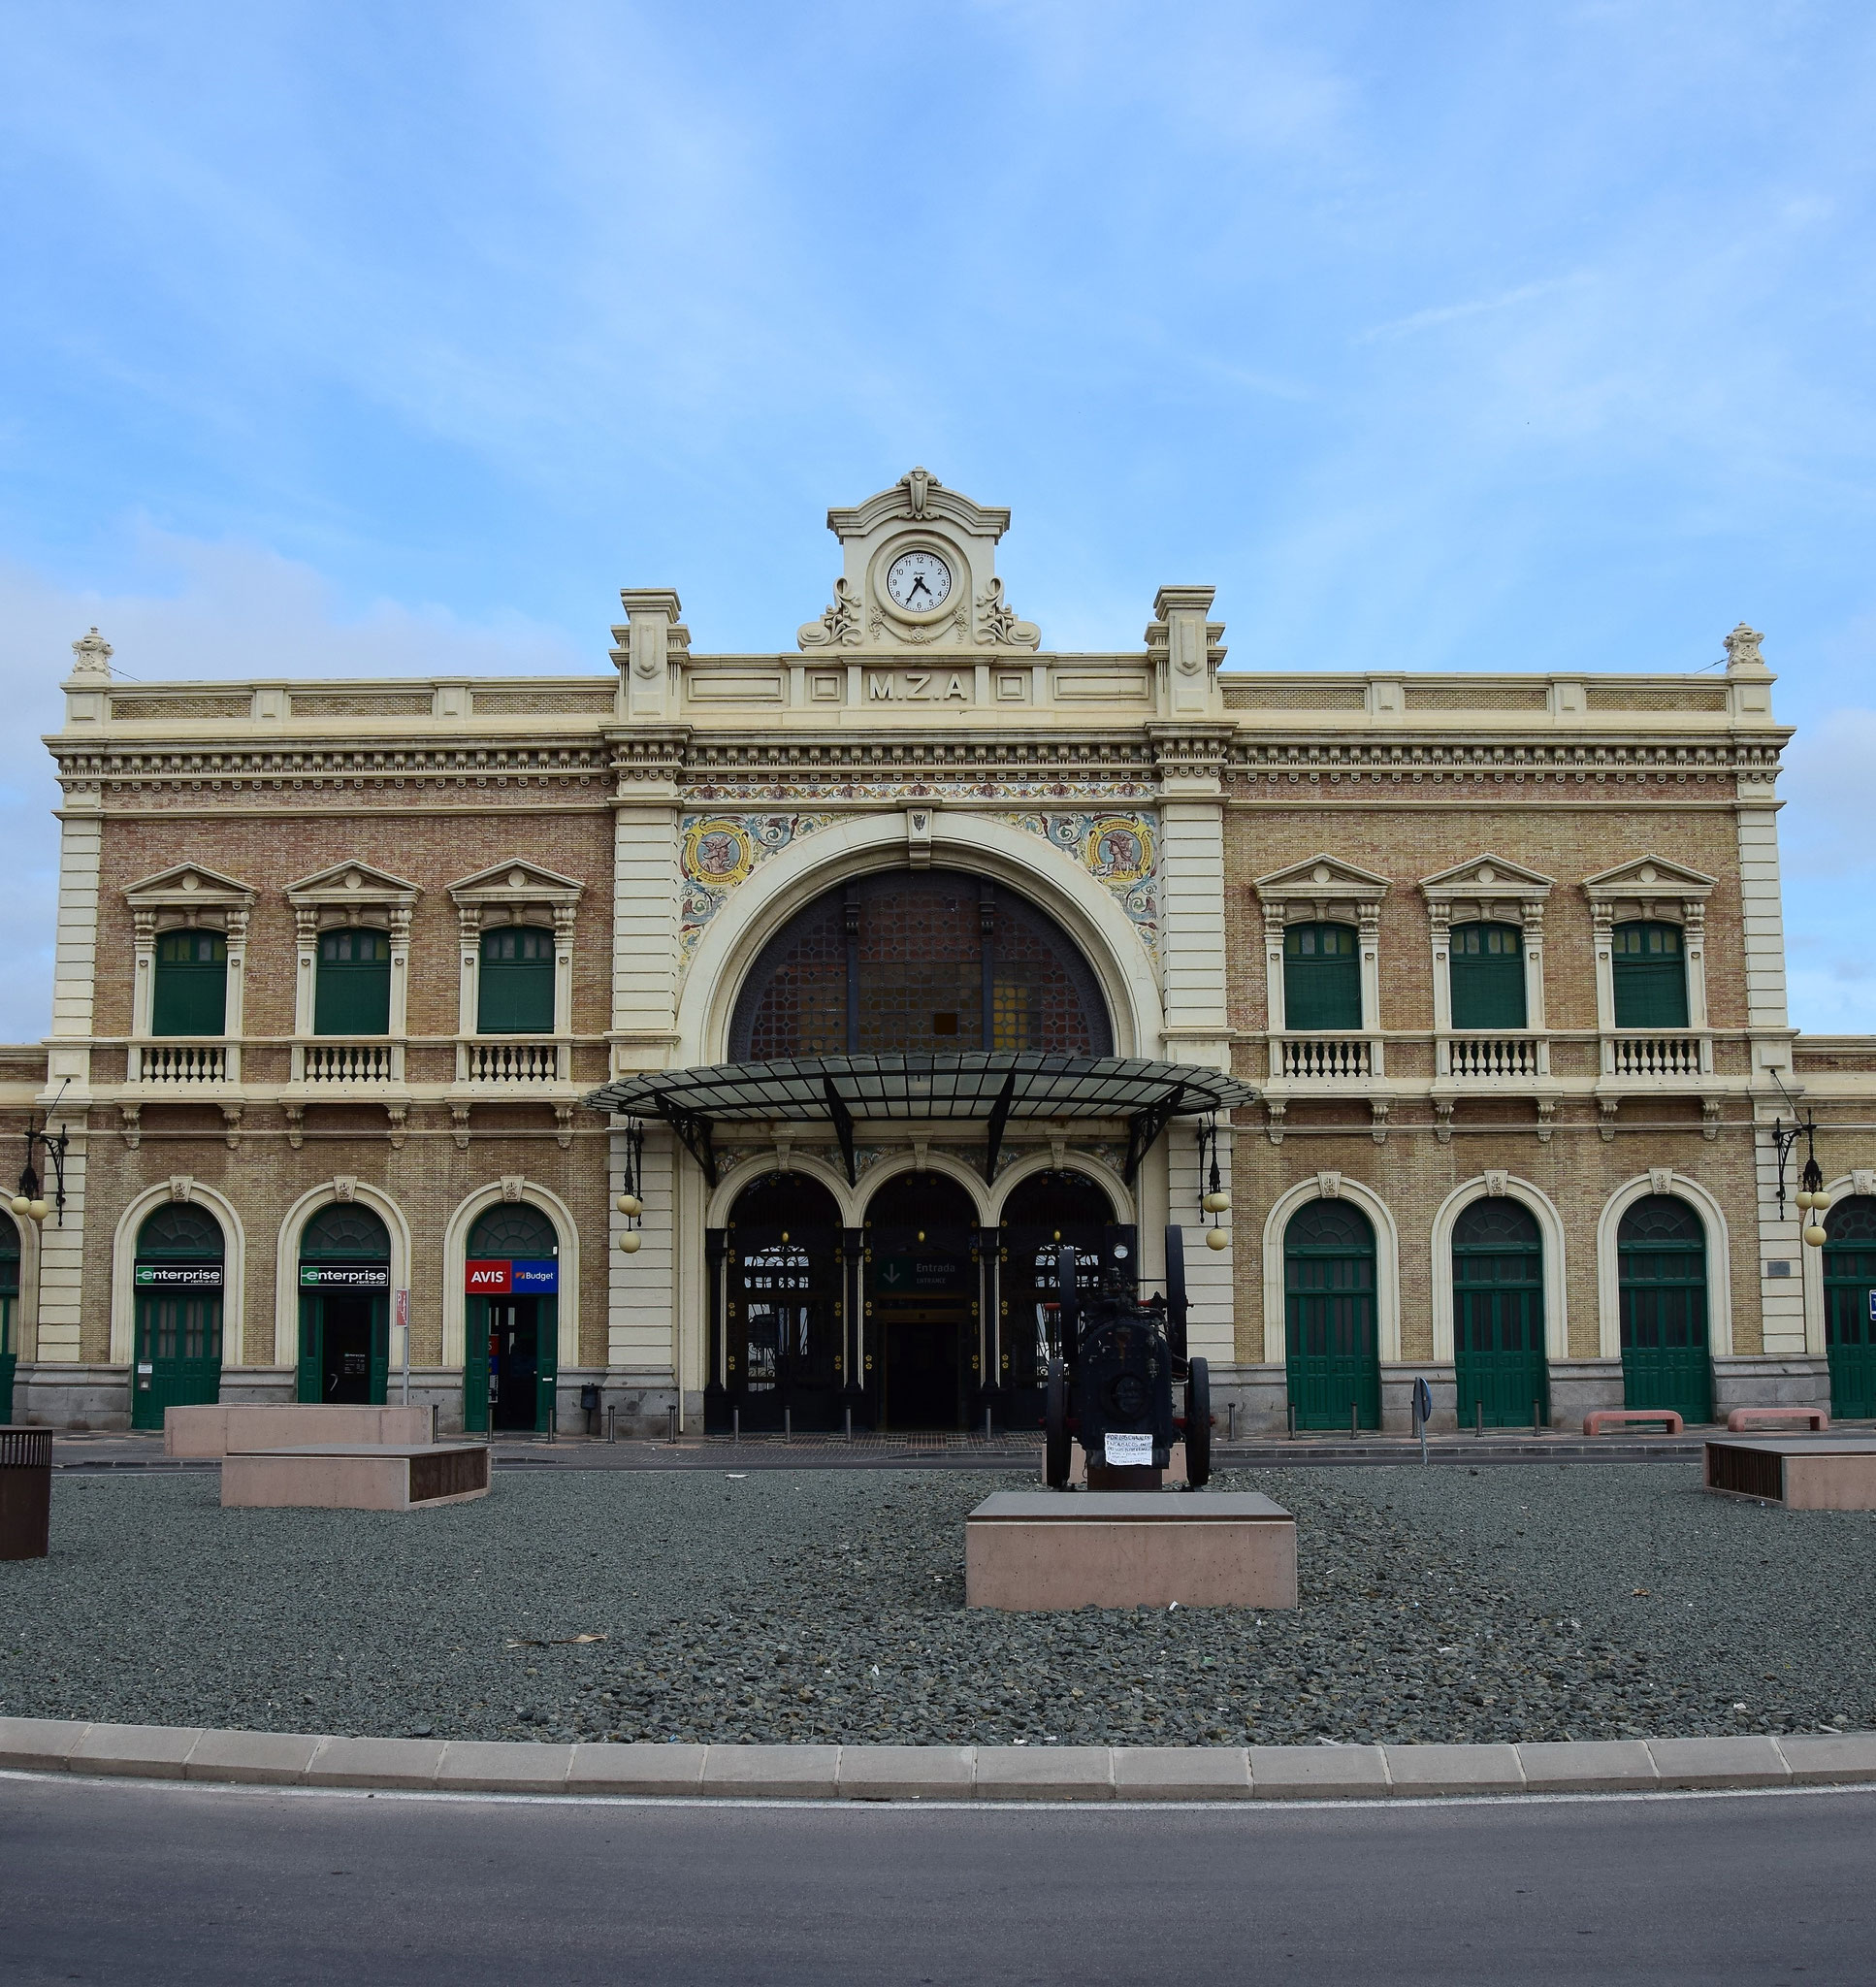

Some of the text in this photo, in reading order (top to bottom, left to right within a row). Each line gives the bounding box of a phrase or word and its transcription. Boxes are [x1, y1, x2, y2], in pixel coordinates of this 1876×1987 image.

[916, 1263, 955, 1272] Entrada
[141, 1269, 220, 1282] enterprise
[306, 1270, 386, 1283] enterprise
[471, 1271, 504, 1283] AVIS
[526, 1272, 553, 1281] Budget
